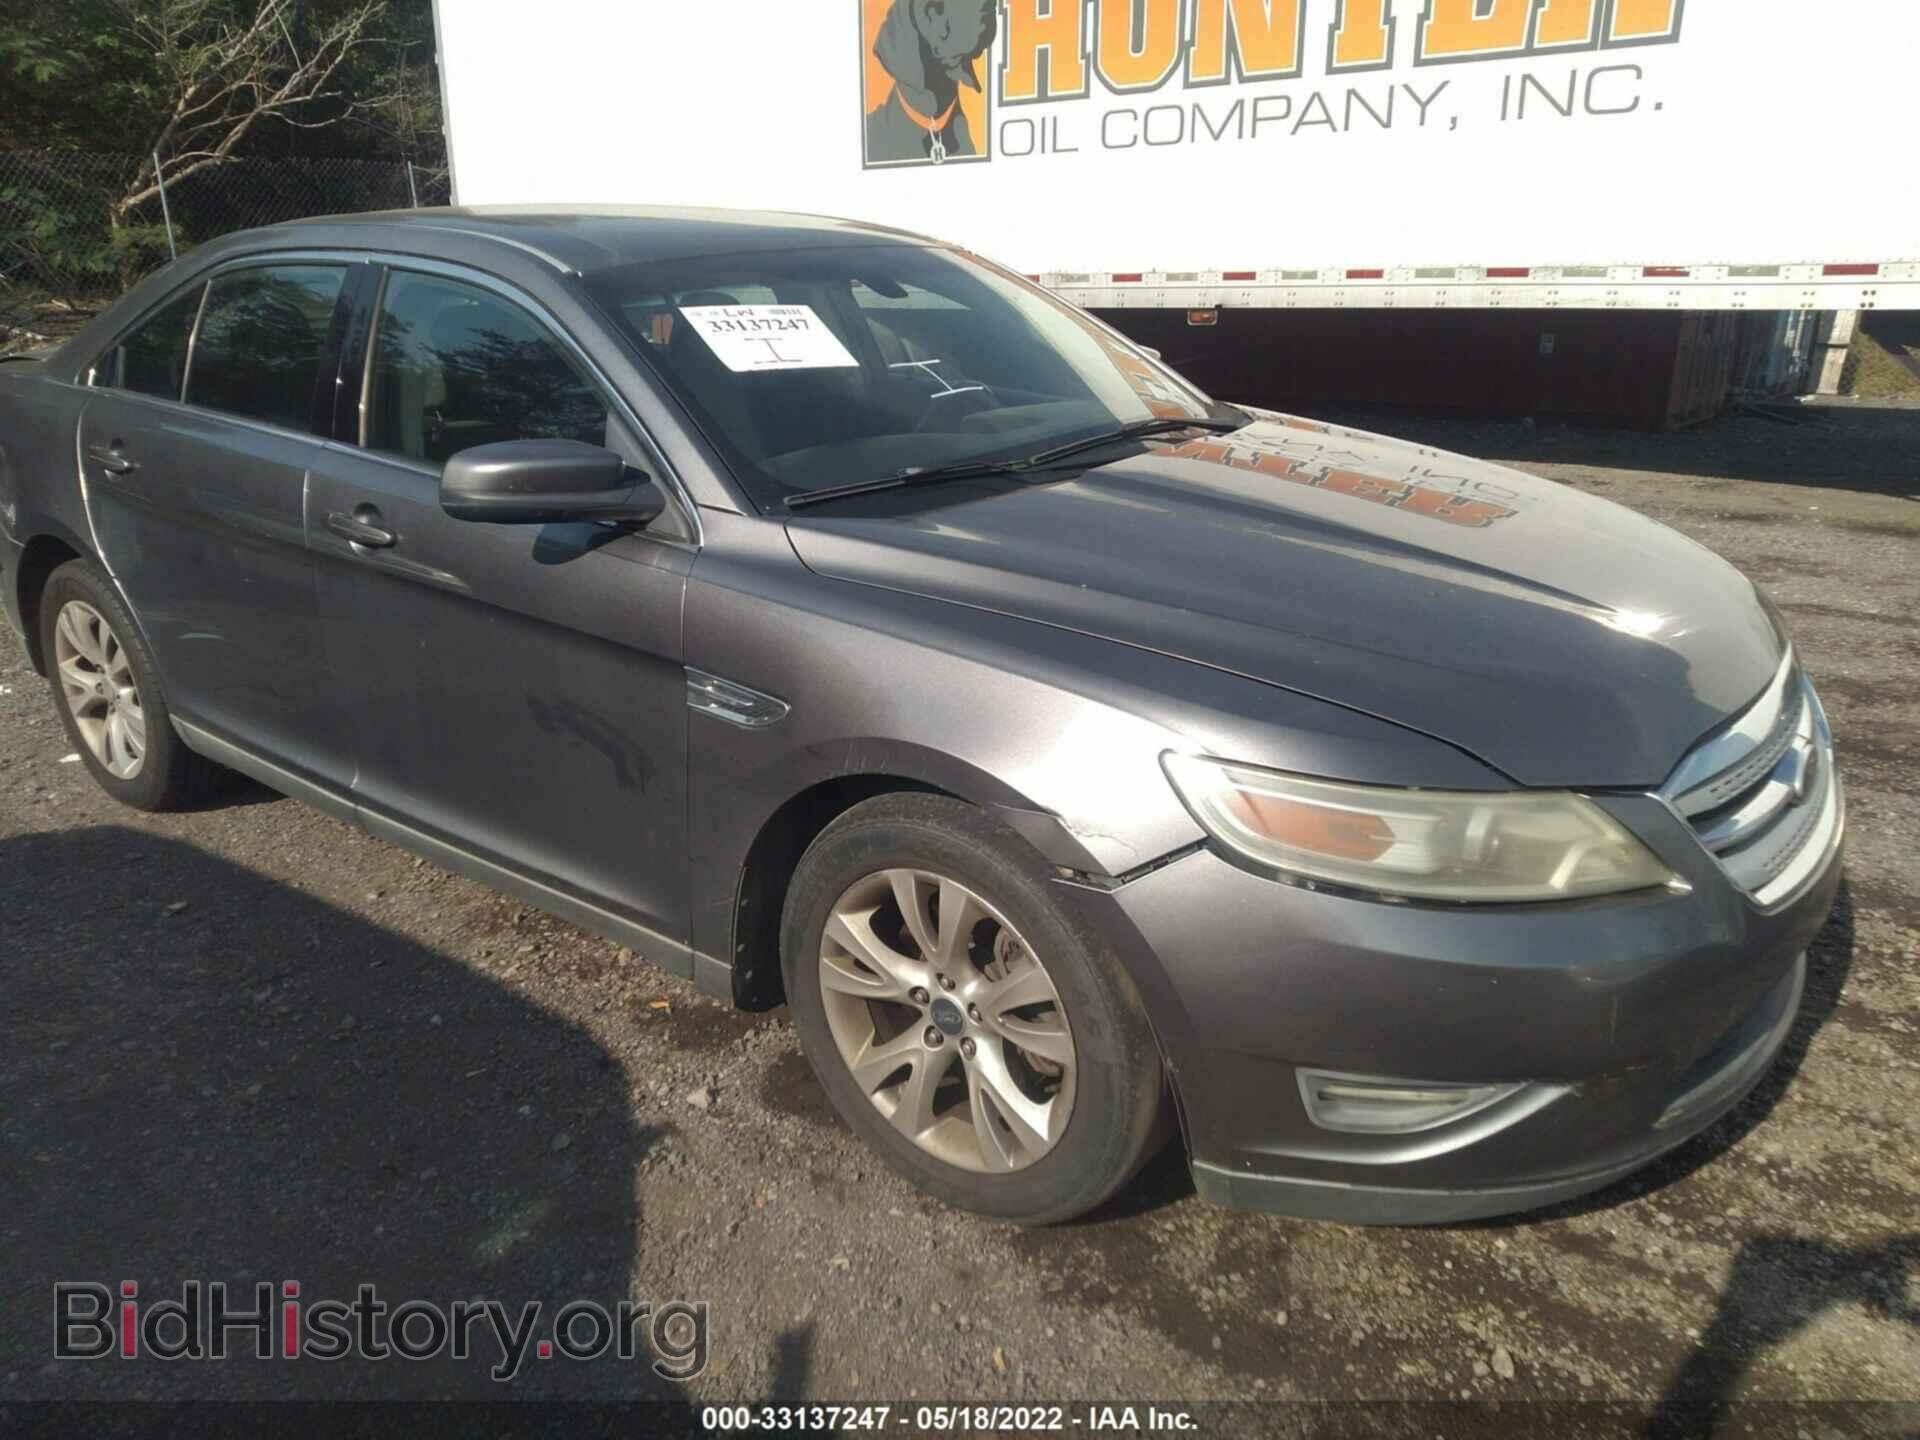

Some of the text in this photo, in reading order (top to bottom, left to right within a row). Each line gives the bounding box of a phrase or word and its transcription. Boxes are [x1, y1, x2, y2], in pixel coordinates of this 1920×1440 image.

[1000, 64, 1663, 156] OIL COMPANY, INC.
[707, 319, 809, 333] 33137247
